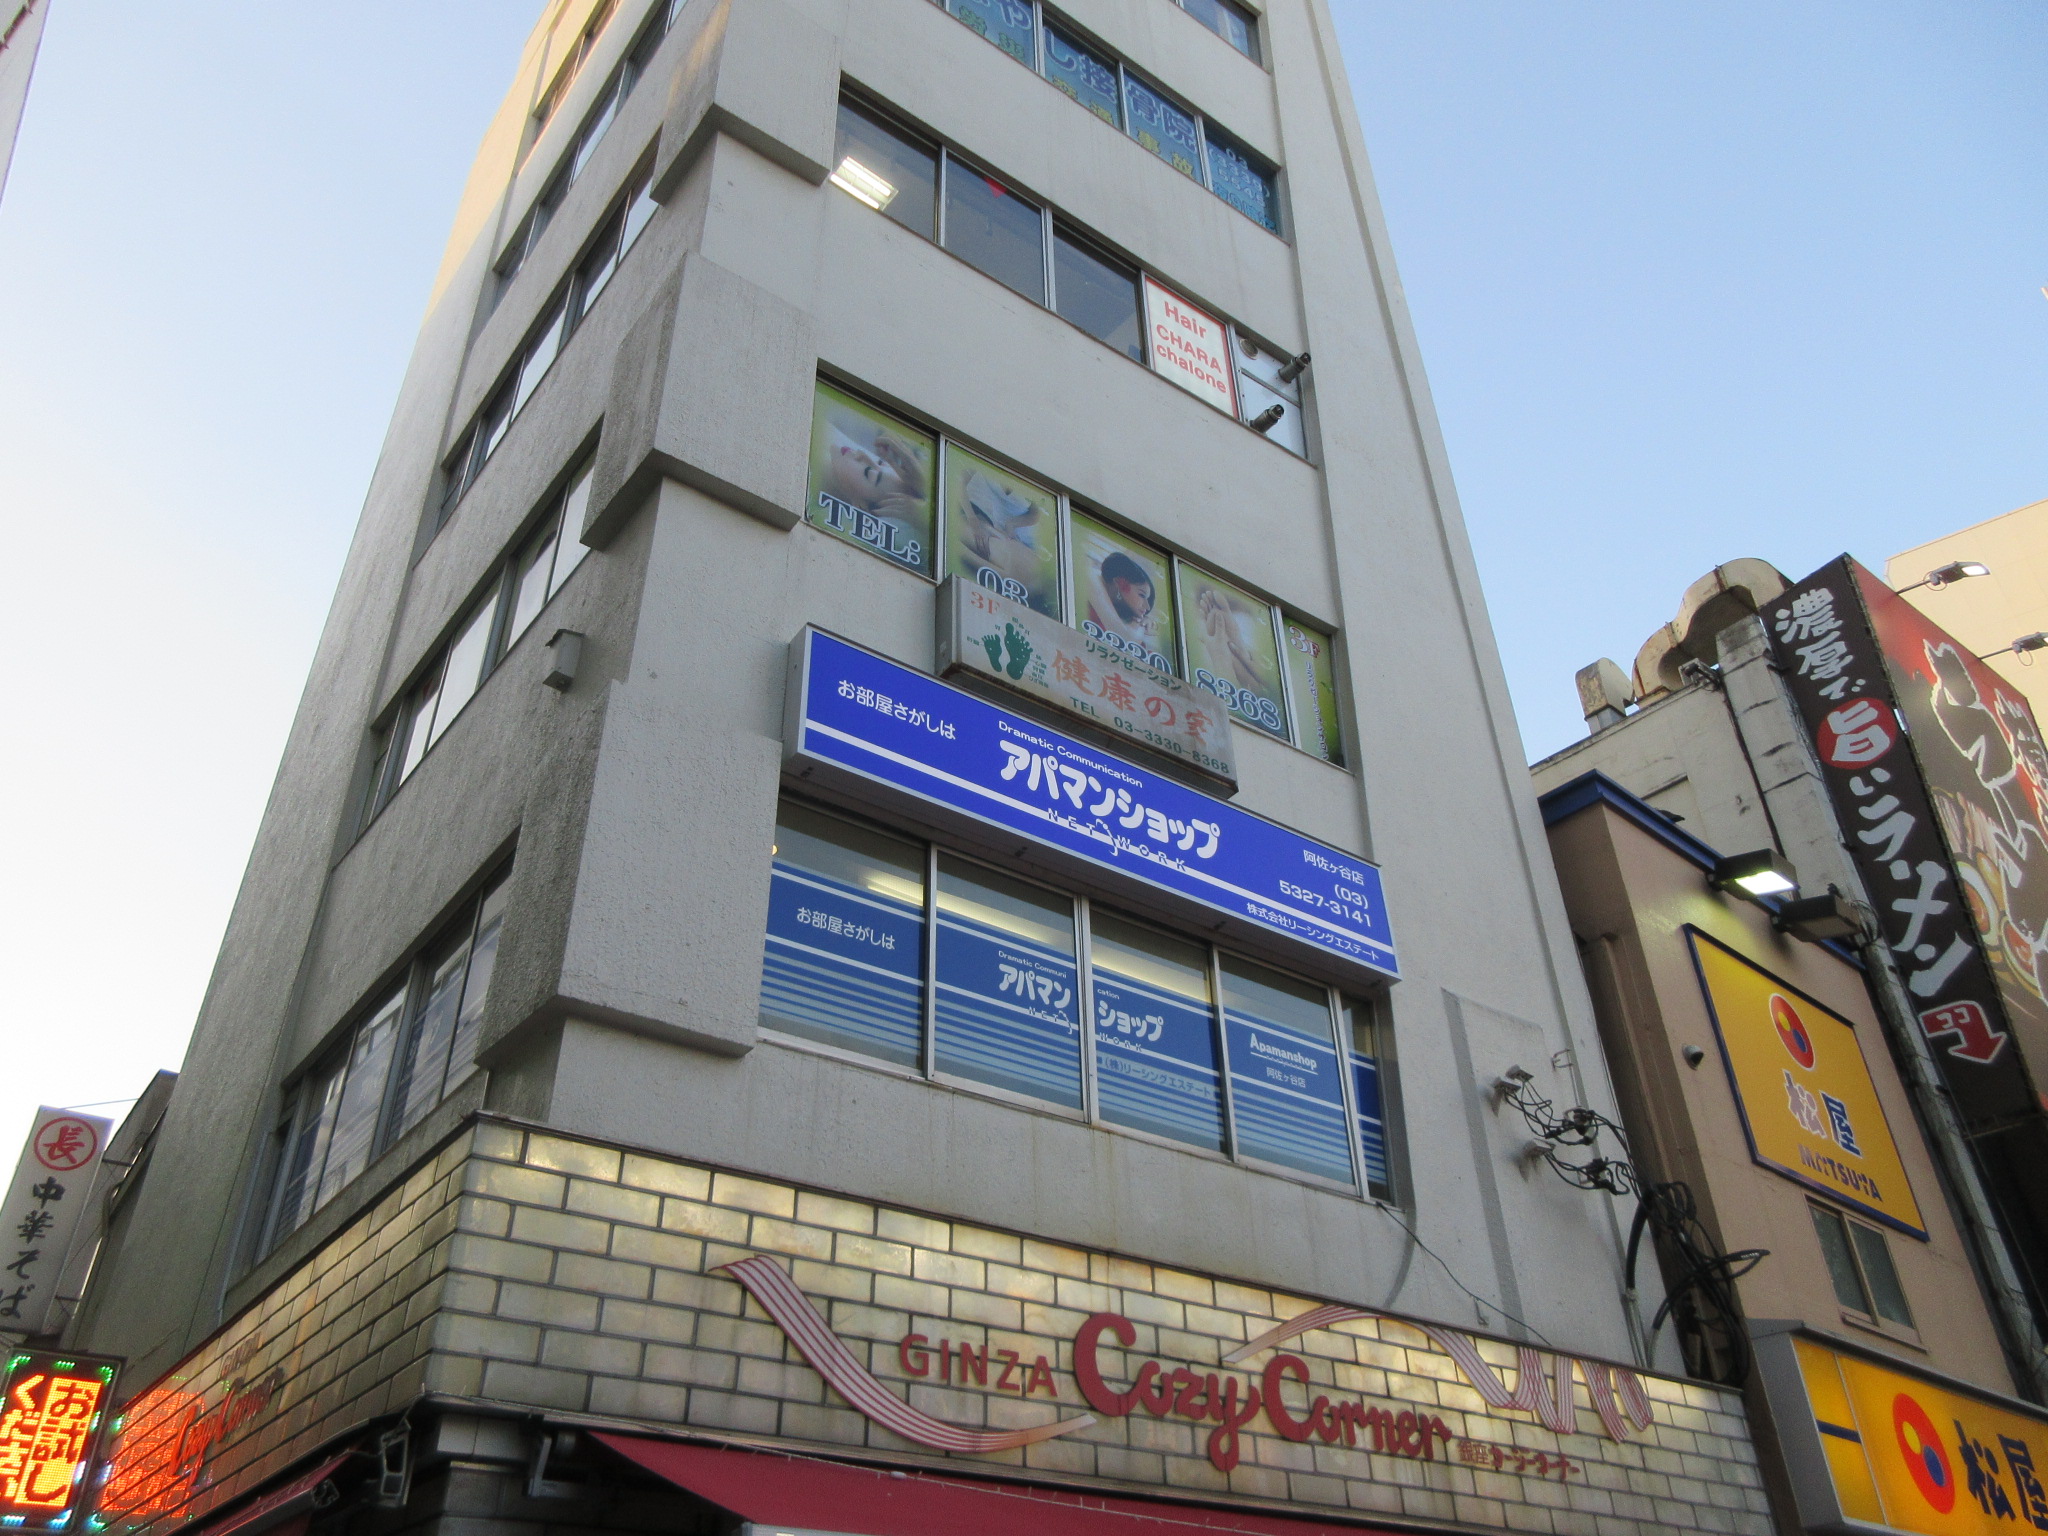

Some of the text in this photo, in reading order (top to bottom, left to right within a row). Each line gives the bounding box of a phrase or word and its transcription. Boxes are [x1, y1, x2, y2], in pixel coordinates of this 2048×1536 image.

[1164, 300, 1207, 339] Hair
[1156, 324, 1222, 374] CHARA
[1156, 344, 1227, 394] chalone
[818, 491, 922, 566] TEL:
[1195, 667, 1281, 730] 8368
[970, 590, 1001, 615] 3F
[1085, 639, 1182, 691] リラクゼーション
[1289, 625, 1321, 659] 3F
[837, 679, 956, 740] お部屋さがしは
[1069, 696, 1230, 774] TEL 03-3330-8368
[998, 720, 1143, 788] Dramatic Communication
[999, 739, 1221, 859] アパマンショップ
[1279, 879, 1372, 927] 5327-3141
[1334, 884, 1369, 909] (03)
[796, 907, 895, 951] お部屋さがしは
[1246, 902, 1379, 961] 株式会社リーシングエステート
[998, 950, 1033, 968] Dramatic
[1250, 1032, 1317, 1071] Apamanshop
[1783, 1068, 1863, 1159] 松屋
[43, 1124, 85, 1165] 長
[0, 1175, 66, 1320] 中華そば
[900, 1312, 1453, 1472] GINZA Cozy Corner
[24, 1381, 94, 1502] お試し
[1953, 1419, 2048, 1532] 松屋
